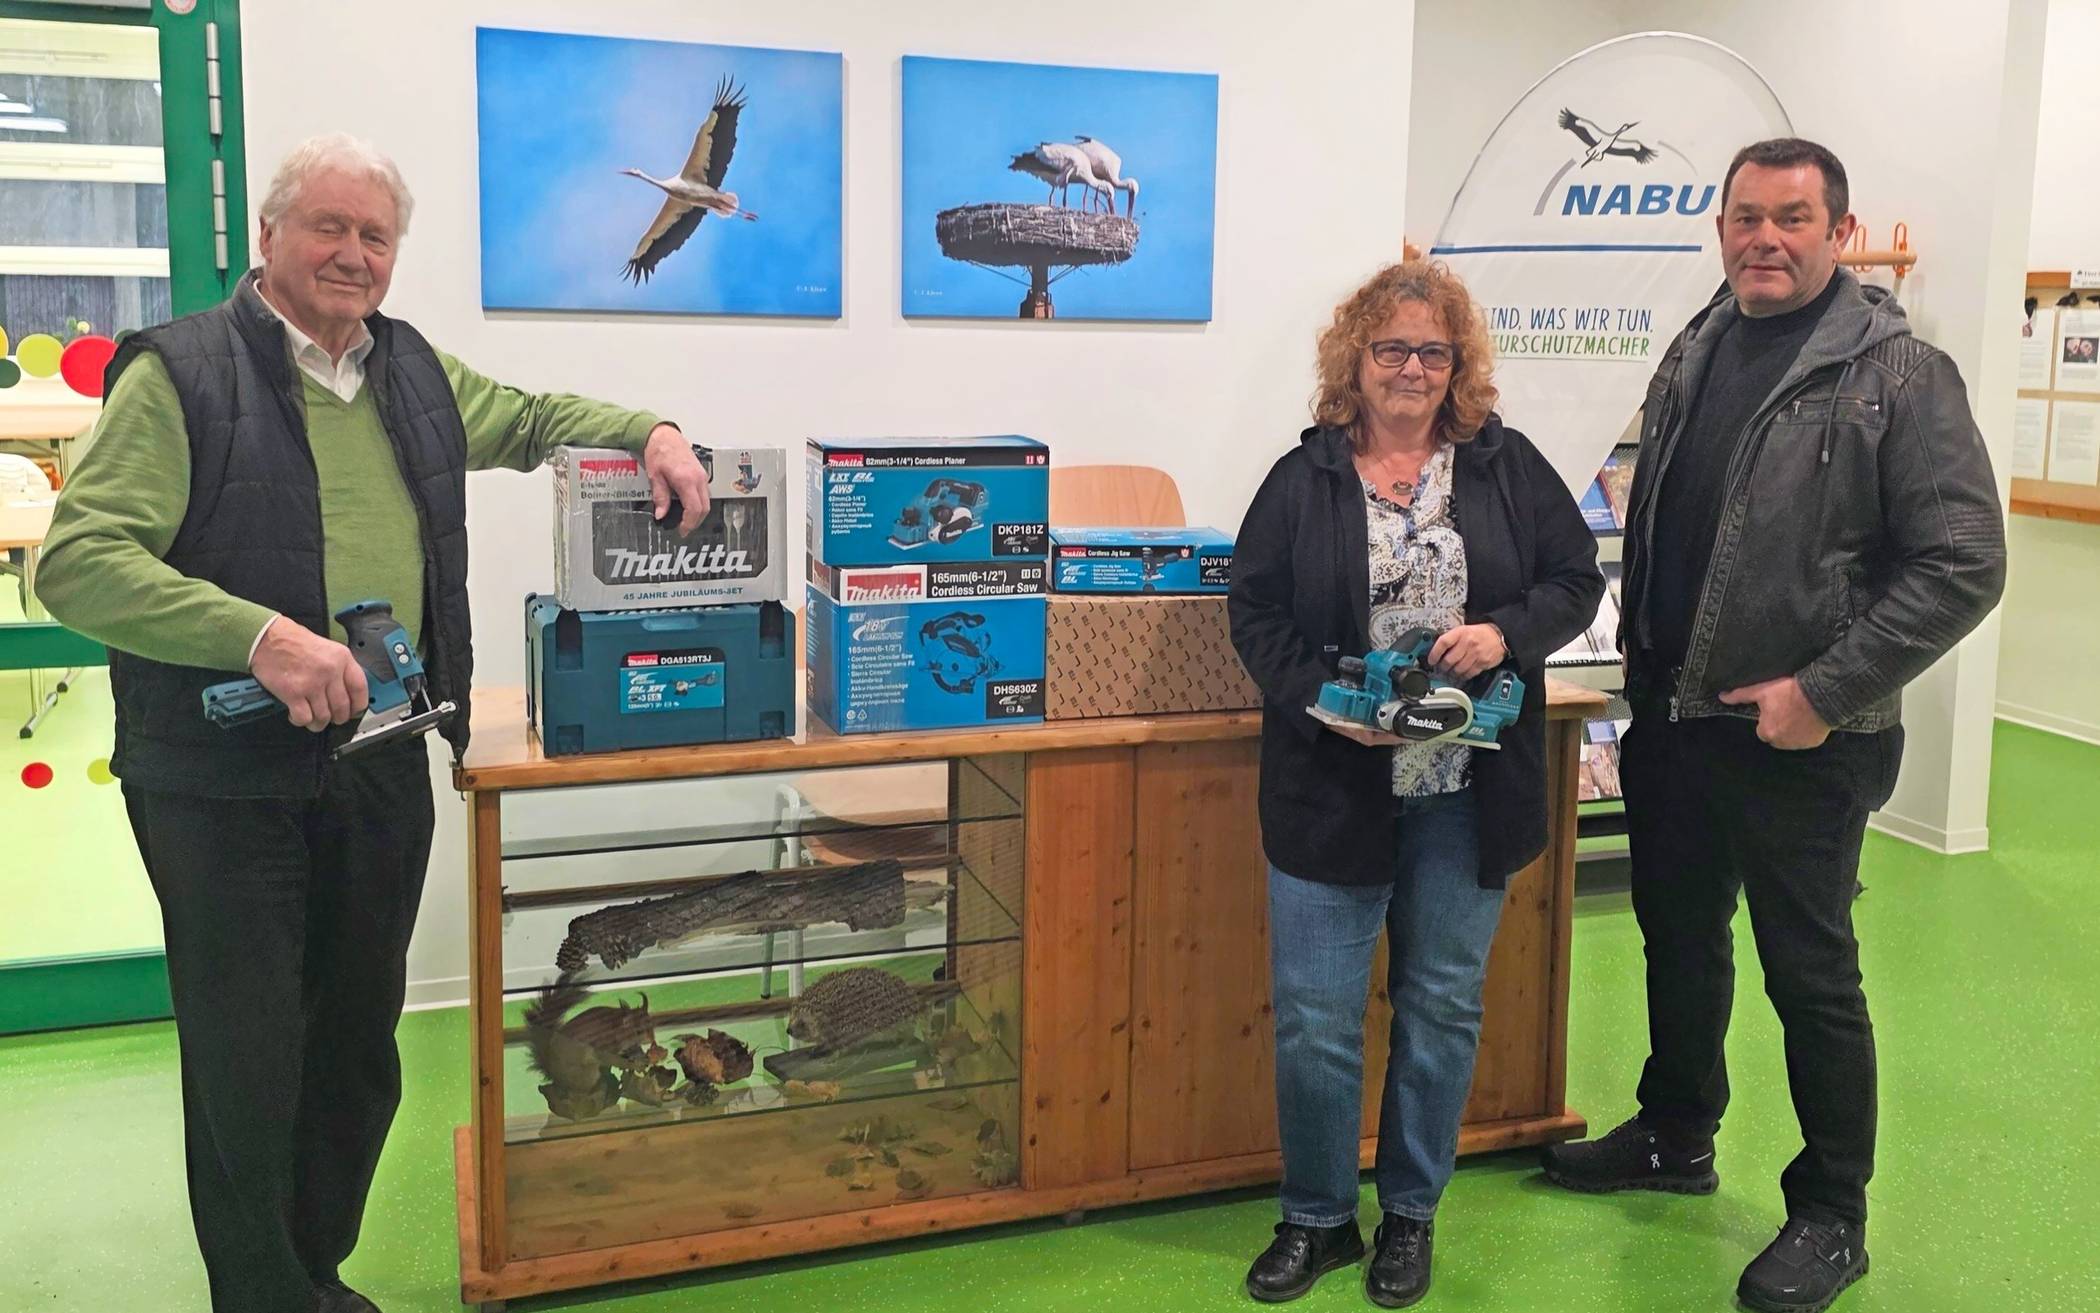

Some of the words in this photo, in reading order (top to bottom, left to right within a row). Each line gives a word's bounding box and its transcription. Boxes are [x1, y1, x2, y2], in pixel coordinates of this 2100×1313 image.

[1562, 184, 1717, 216] NABU
[1489, 307, 1521, 331] IND,
[1530, 307, 1567, 330] WAS
[1575, 308, 1610, 331] WIR
[1617, 308, 1653, 333] TUN.
[1492, 334, 1650, 356] TURSCHUTZMACHER
[914, 457, 943, 465] Cordless
[944, 456, 966, 465] Planer
[998, 524, 1044, 535] DKP181Z
[605, 544, 753, 578] Makita
[931, 570, 1007, 585] 165mm(6-1/2")
[623, 592, 635, 600] 45
[637, 591, 668, 600] JAHRE
[847, 584, 919, 601] Makita
[931, 585, 974, 597] Cordless
[976, 583, 1015, 595] Circular
[1016, 582, 1039, 593] Saw
[993, 684, 1038, 695] DHS630Z
[1406, 715, 1444, 730] Makita
